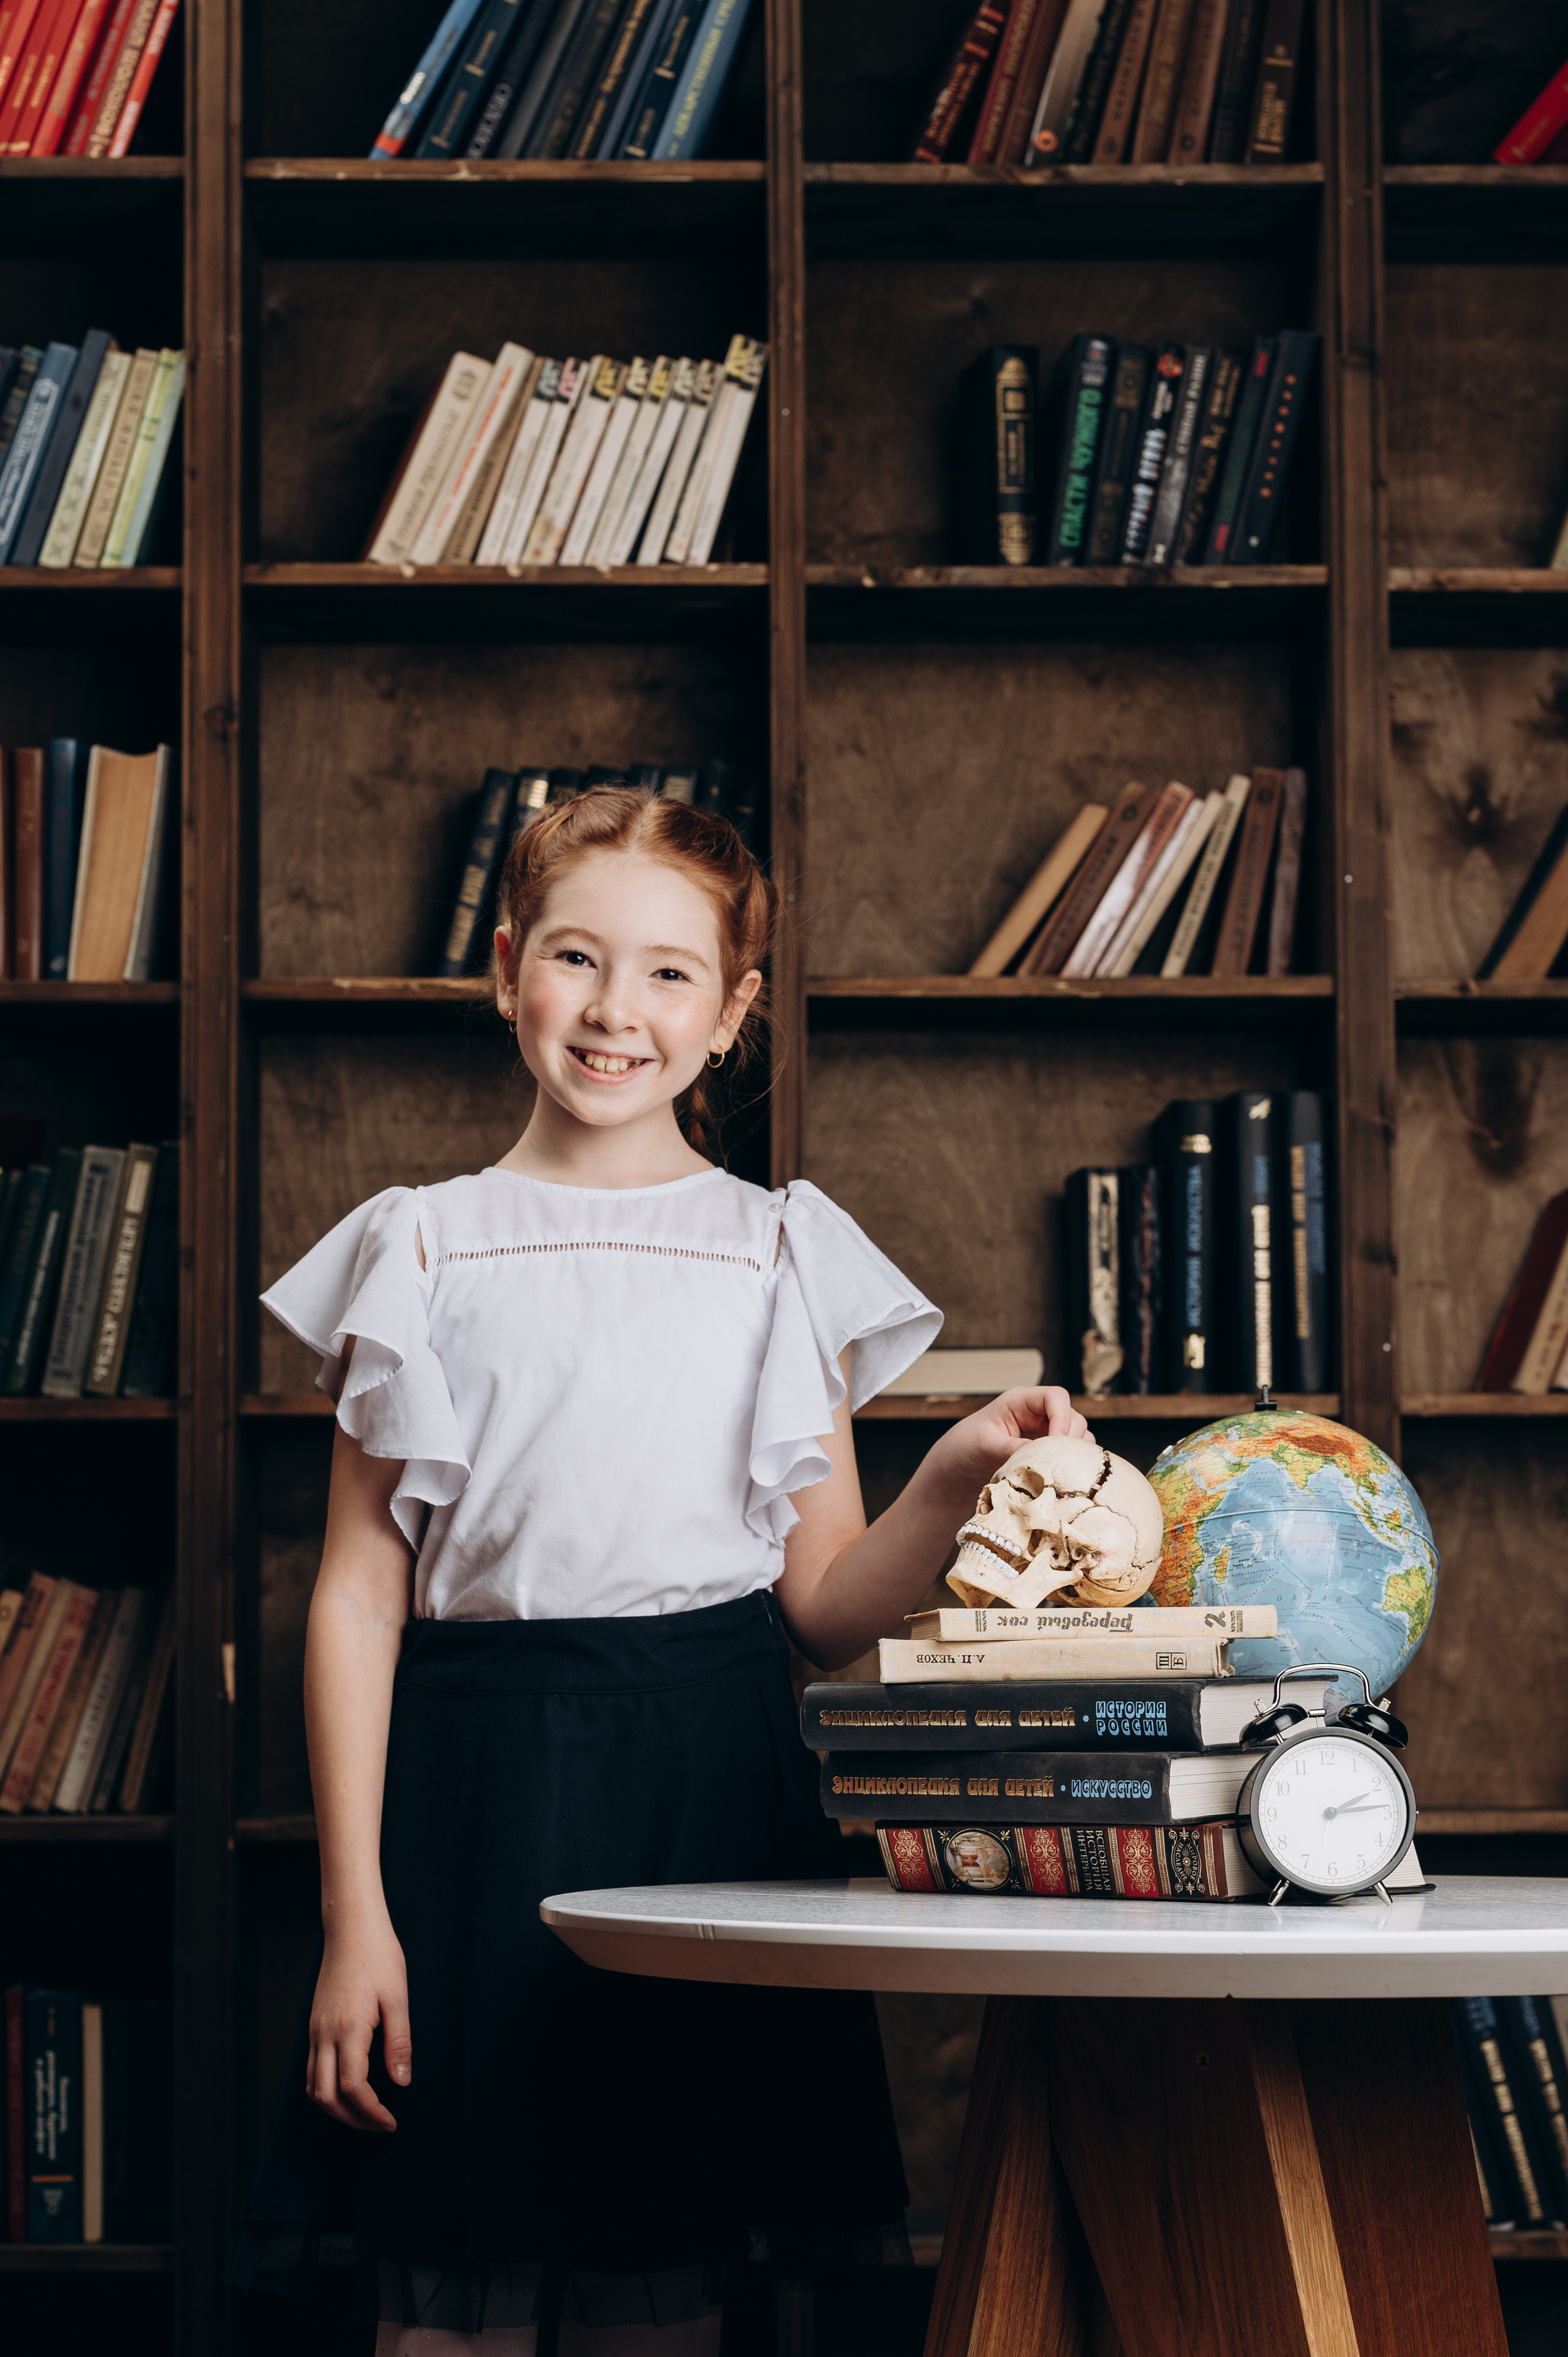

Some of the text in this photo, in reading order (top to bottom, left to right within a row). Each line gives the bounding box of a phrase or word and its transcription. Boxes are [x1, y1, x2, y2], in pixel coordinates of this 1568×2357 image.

[1276, 1594, 1342, 1603] ОКЕАН
[997, 1611, 1134, 1633] Березовый сок
[916, 1654, 956, 1664] ЧЕХОВ
[819, 1701, 1167, 1727] ЭНЦИКЛОПЕДИЯ ДЛЯ ДЕТЕЙ ИСТОРИЯ
[1096, 1719, 1168, 1736] РОССИИ
[1319, 1750, 1335, 1766] 12
[1351, 1757, 1358, 1772] 1
[1294, 1760, 1308, 1776] 11
[832, 1775, 1153, 1799] ЭНЦИКЛОПЕДИЯ ДЛЯ ДЕТЕЙ ИСКУССТВО
[1275, 1780, 1291, 1796] 10
[1371, 1776, 1382, 1792] 2
[1267, 1807, 1278, 1822] 9
[1382, 1804, 1393, 1820] 3
[1278, 1834, 1288, 1850] 8
[1373, 1832, 1385, 1847] 4
[1076, 1829, 1093, 1891] ИНТЕРЬЕРА
[1085, 1829, 1103, 1890] ИСТОРИЯ
[1095, 1829, 1112, 1891] ВСЕОБЩАЯ
[1175, 1842, 1189, 1881] НАСЛЕДИЕ
[1186, 1842, 1199, 1881] МИРОВОЕ
[1300, 1853, 1311, 1870] 7
[1356, 1853, 1366, 1869] 5
[1327, 1861, 1338, 1877] 6
